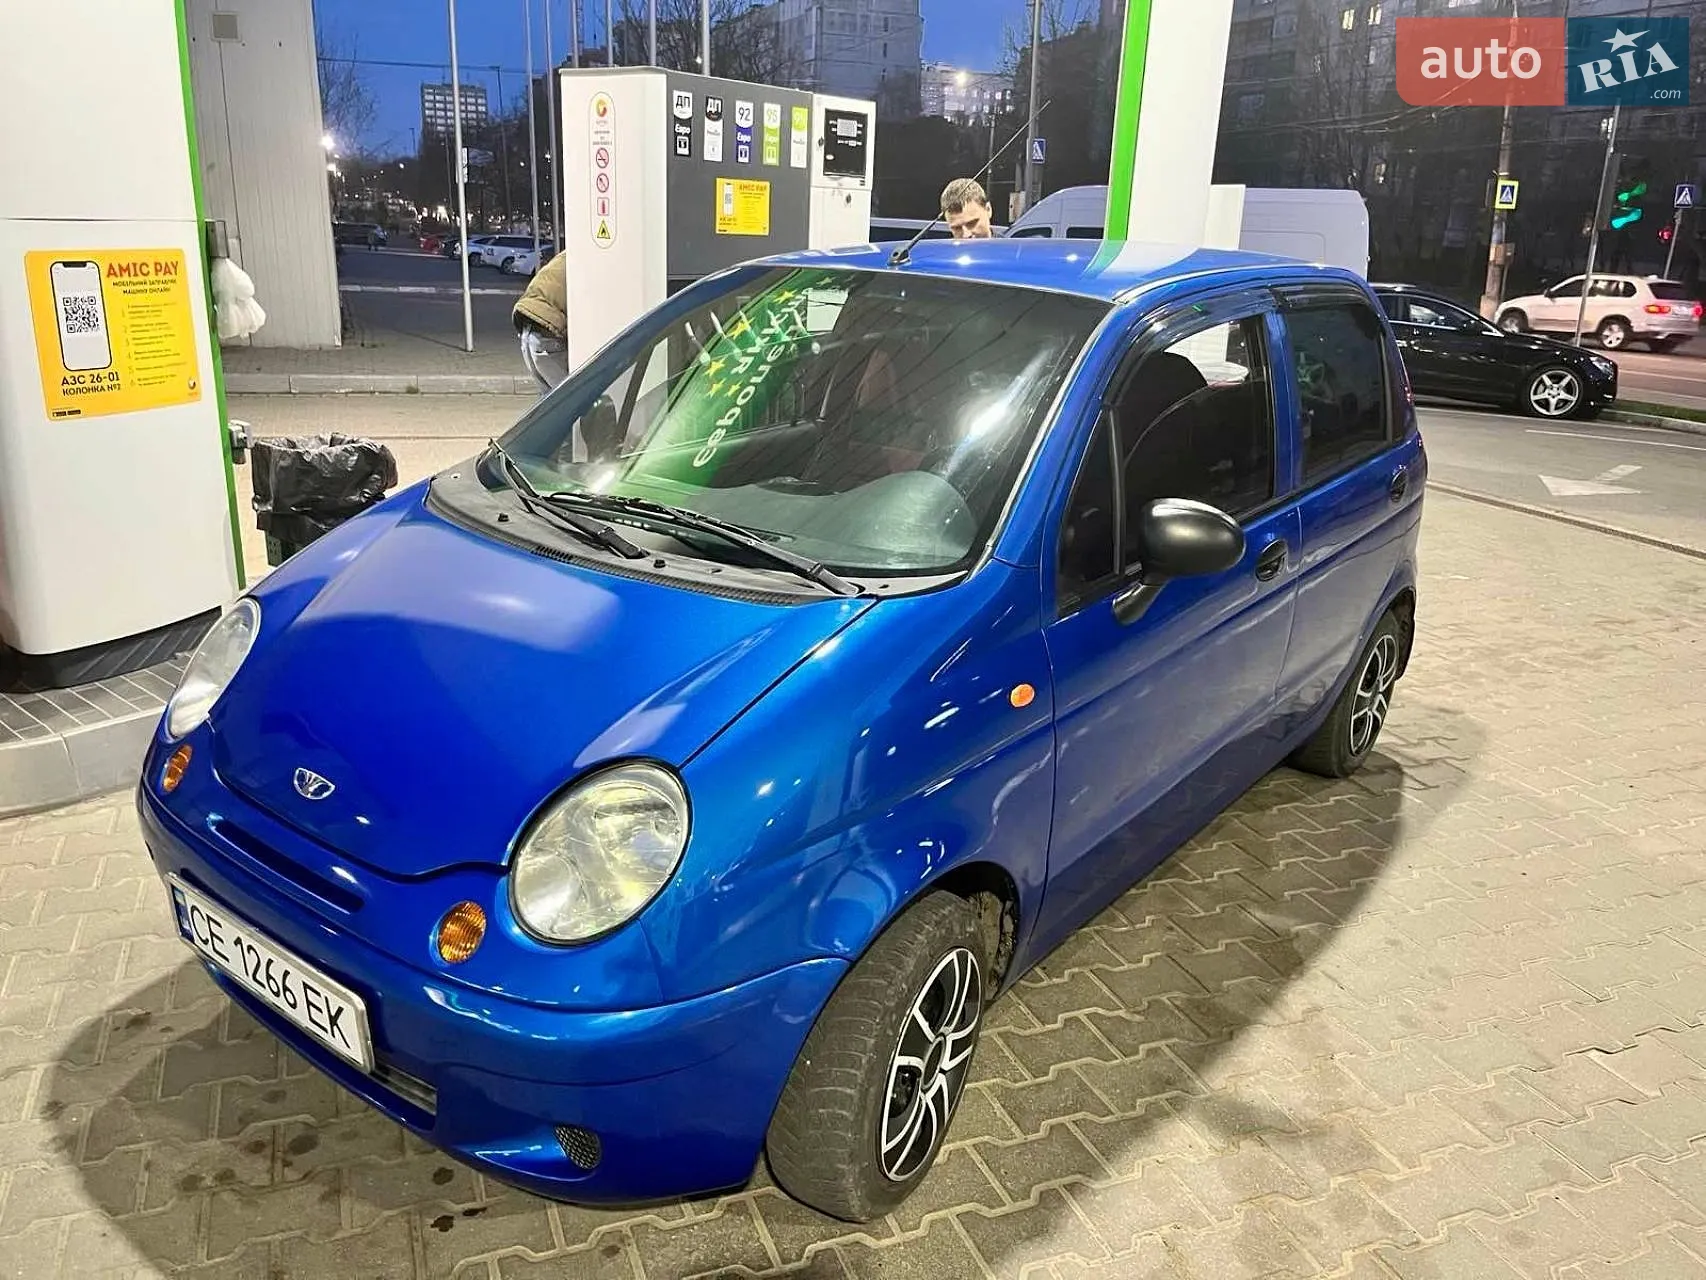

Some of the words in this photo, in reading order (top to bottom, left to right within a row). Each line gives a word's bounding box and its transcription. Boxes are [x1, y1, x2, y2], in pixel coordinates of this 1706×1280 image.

[738, 107, 751, 121] 92
[106, 262, 150, 278] AMIC
[154, 260, 179, 276] PAY
[61, 375, 86, 386] АЗС
[89, 371, 120, 384] 26-01
[190, 904, 230, 963] CE
[233, 936, 298, 1010] 1266
[302, 981, 351, 1049] EK
